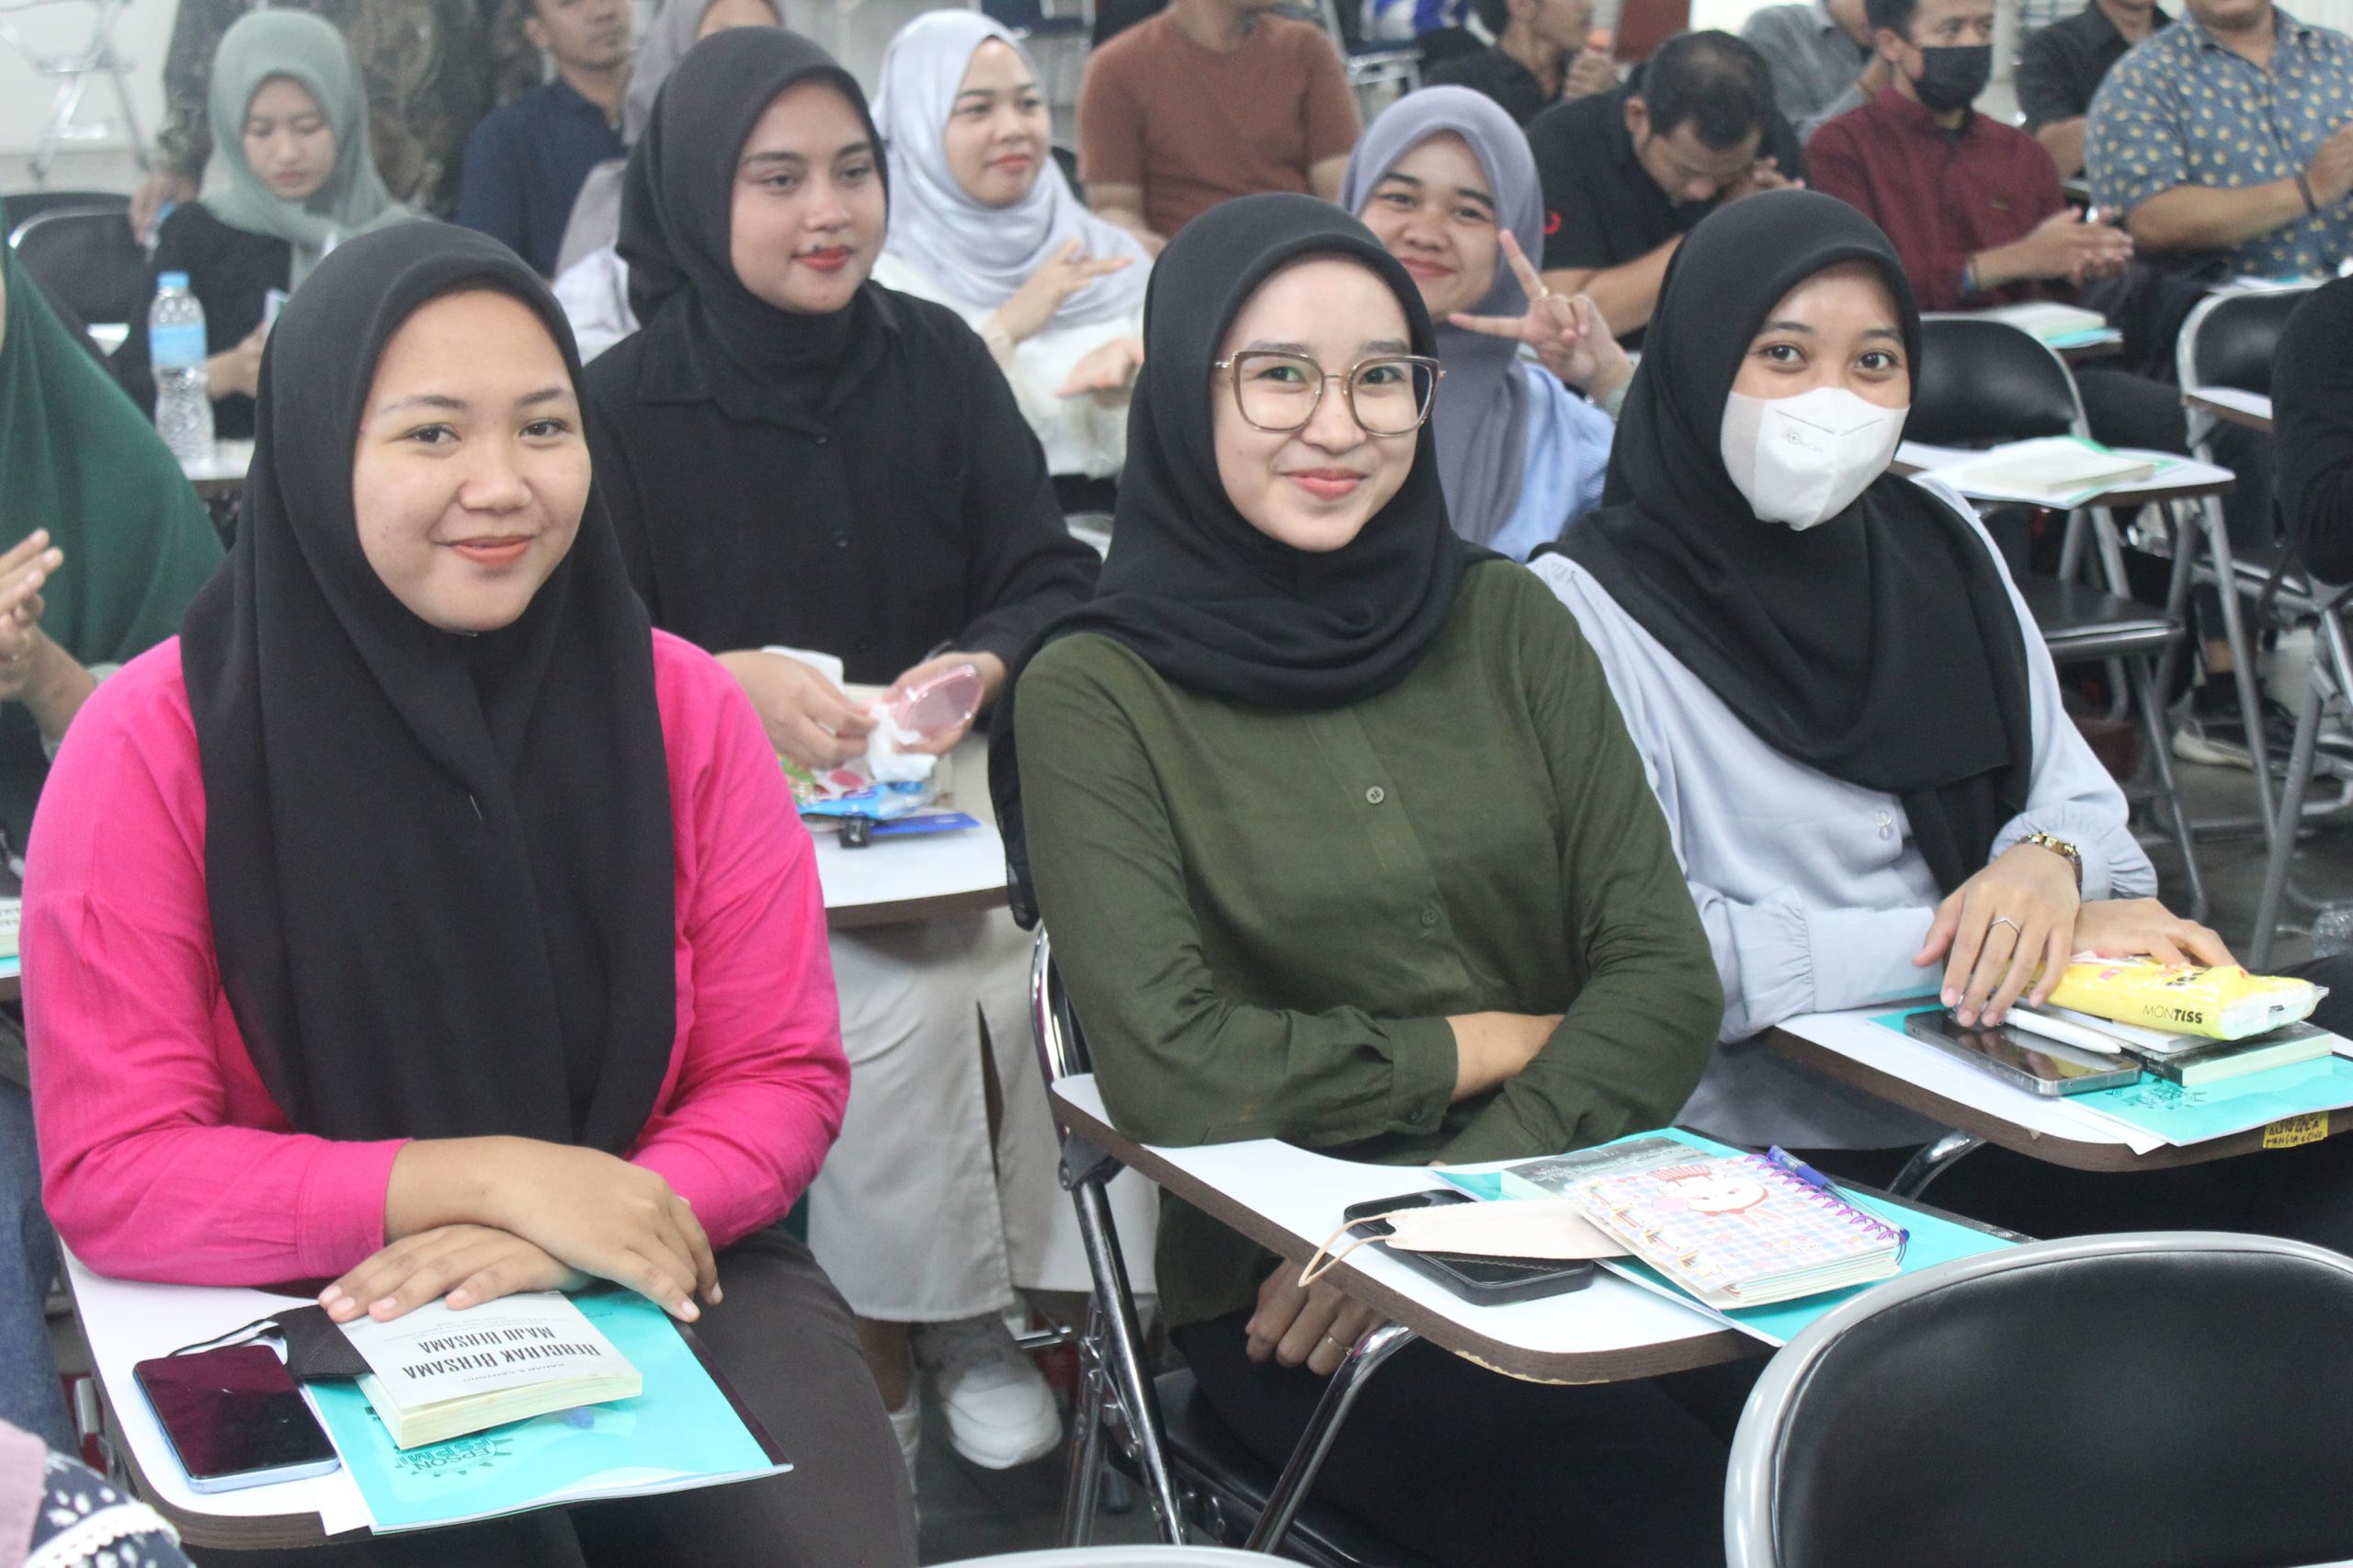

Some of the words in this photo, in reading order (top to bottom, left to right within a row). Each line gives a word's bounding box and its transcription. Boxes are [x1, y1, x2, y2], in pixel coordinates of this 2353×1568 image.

[2143, 1005, 2203, 1024] MONTISS
[418, 1331, 503, 1354] BERSAMA
[503, 1326, 556, 1341] MAJU
[499, 1344, 601, 1364] BERGERAK
[402, 1352, 498, 1380] BERSAMA
[399, 1437, 491, 1466] FSPMI
[415, 1448, 491, 1471] EPSON
